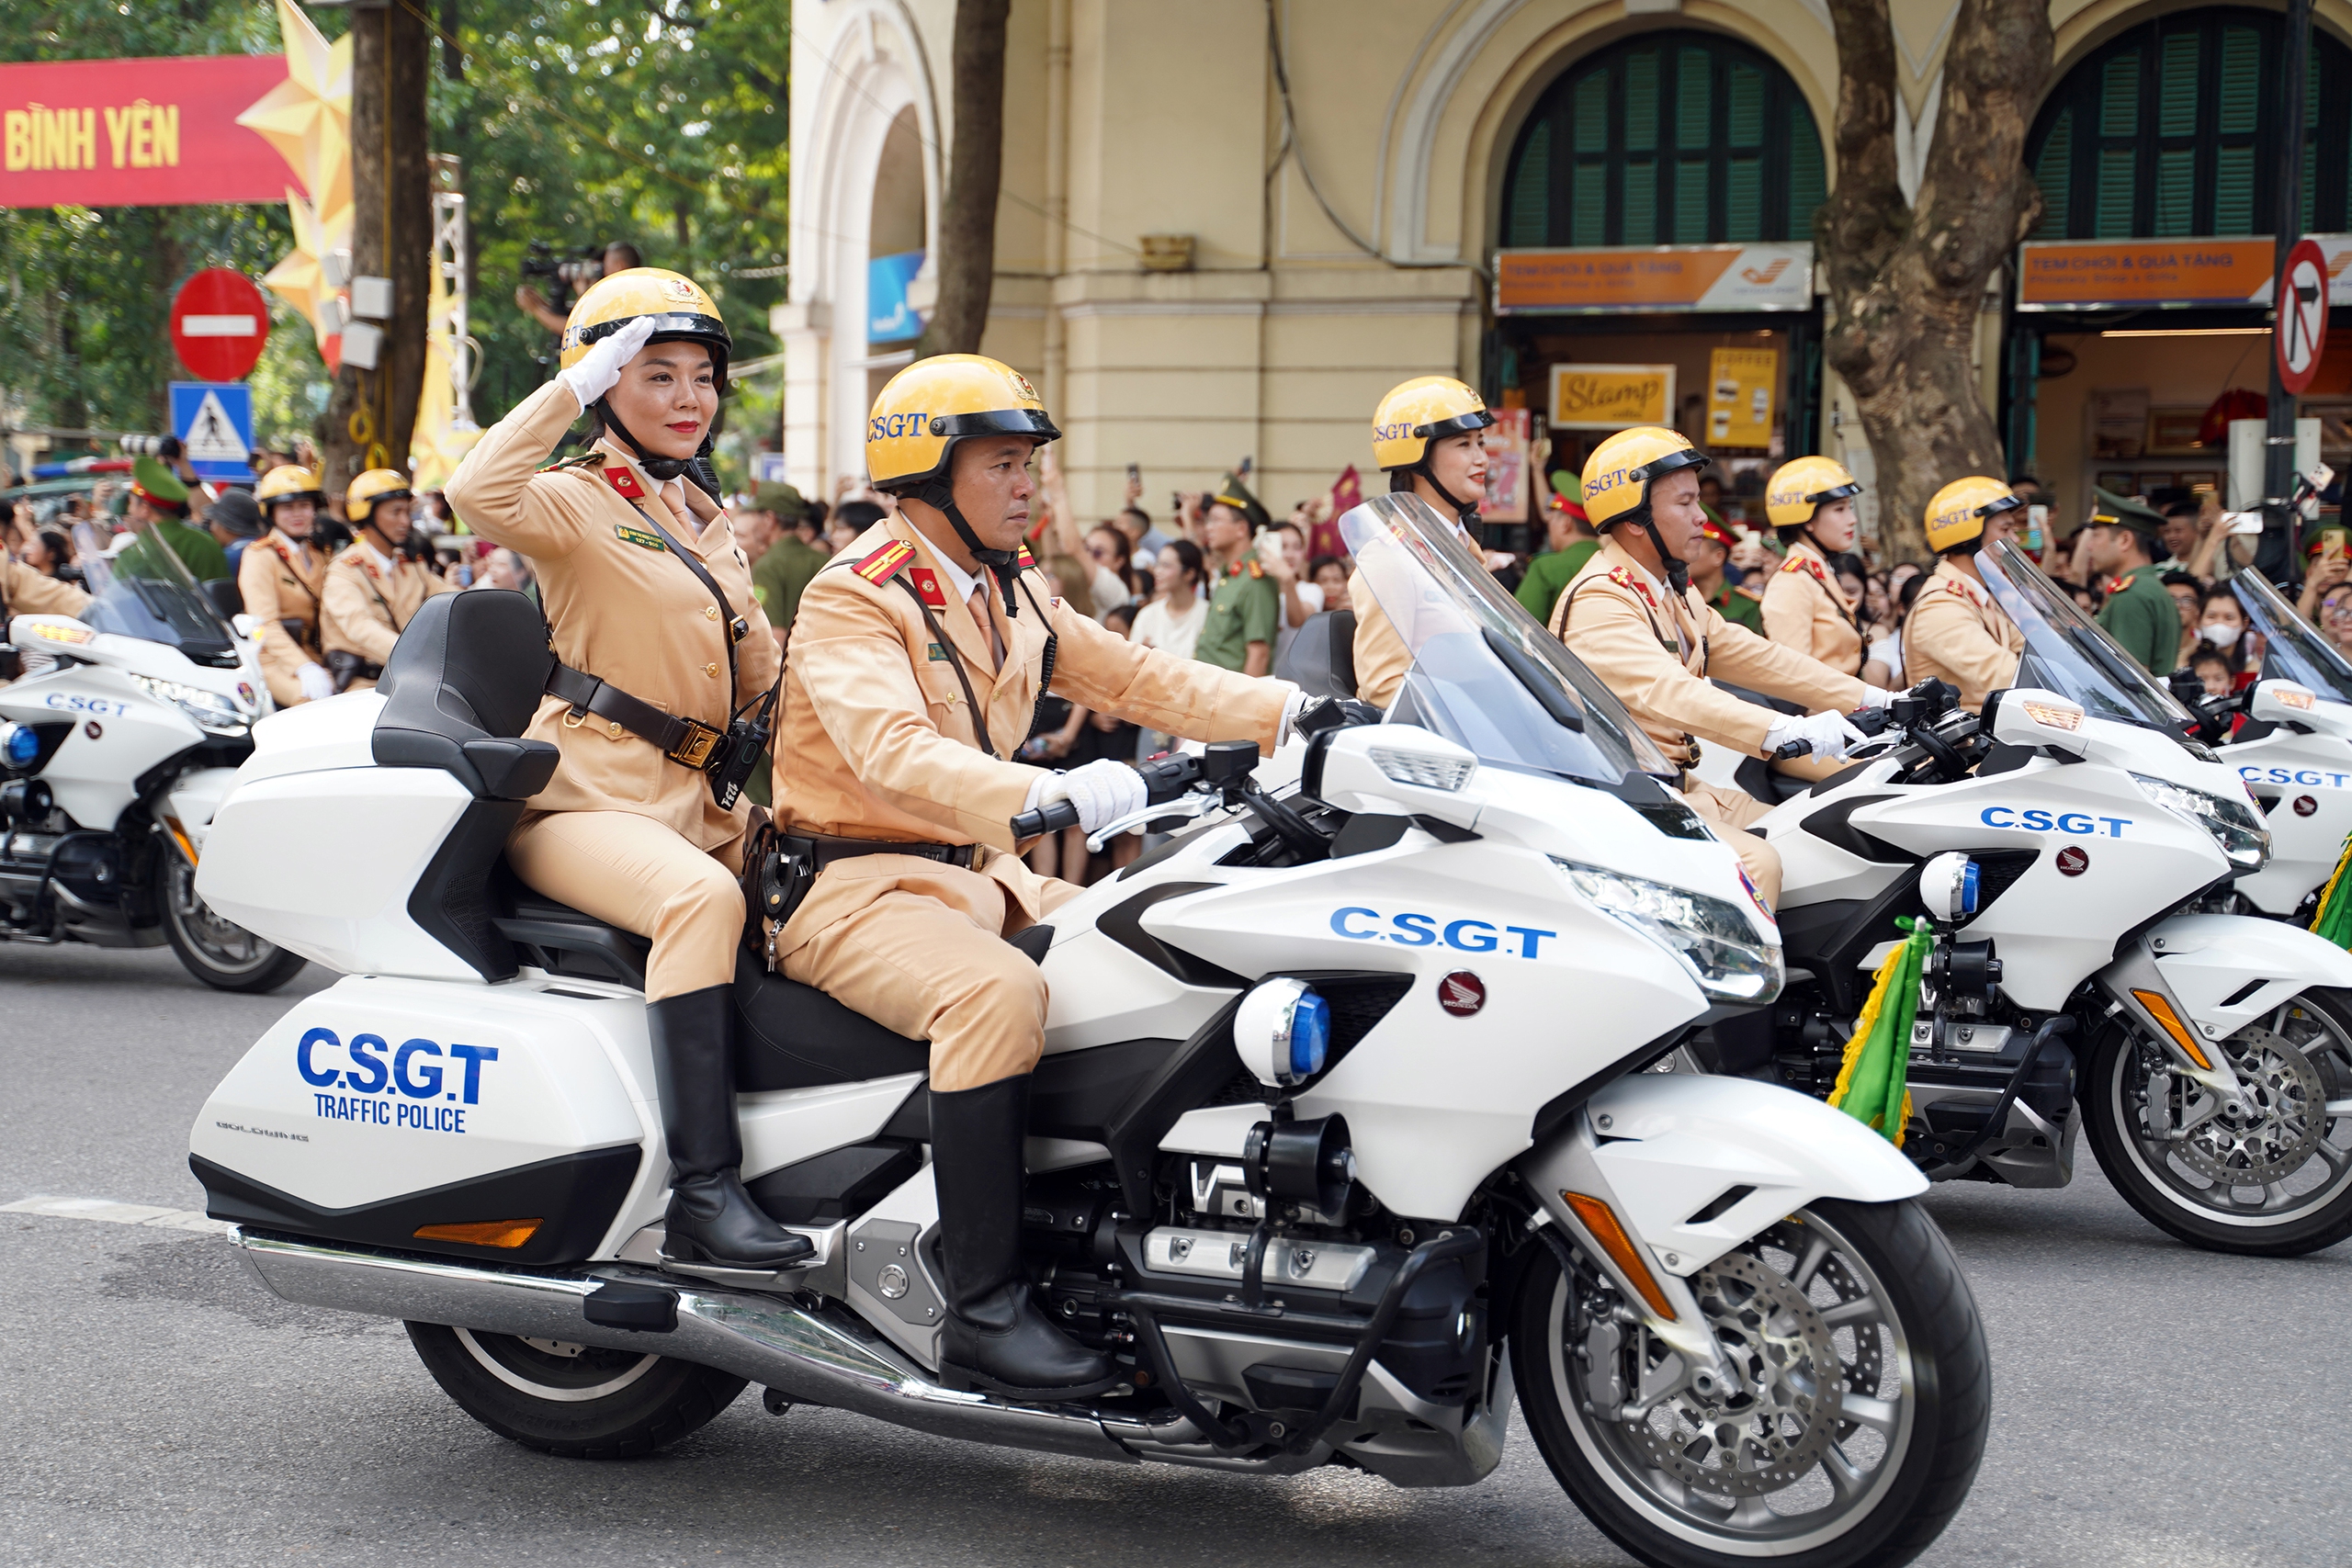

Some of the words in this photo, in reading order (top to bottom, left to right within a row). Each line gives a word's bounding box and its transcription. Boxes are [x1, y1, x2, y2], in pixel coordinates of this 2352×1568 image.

[5, 101, 96, 172] BÌNH
[103, 97, 180, 169] YÊN
[2032, 256, 2066, 271] TEM
[2121, 255, 2134, 269] &
[1565, 374, 1659, 413] Stamp
[867, 412, 928, 444] CSGT
[1583, 468, 1627, 502] CSGT
[1769, 491, 1804, 507] CSGT
[1930, 508, 1971, 532] CSGT
[1981, 807, 2133, 838] C.S.G.T
[1329, 907, 1557, 959] C.S.G.T
[1442, 999, 1479, 1010] HONDA
[297, 1027, 499, 1105] C.S.G.T
[313, 1093, 390, 1126] TRAFFIC
[397, 1103, 466, 1134] POLICE
